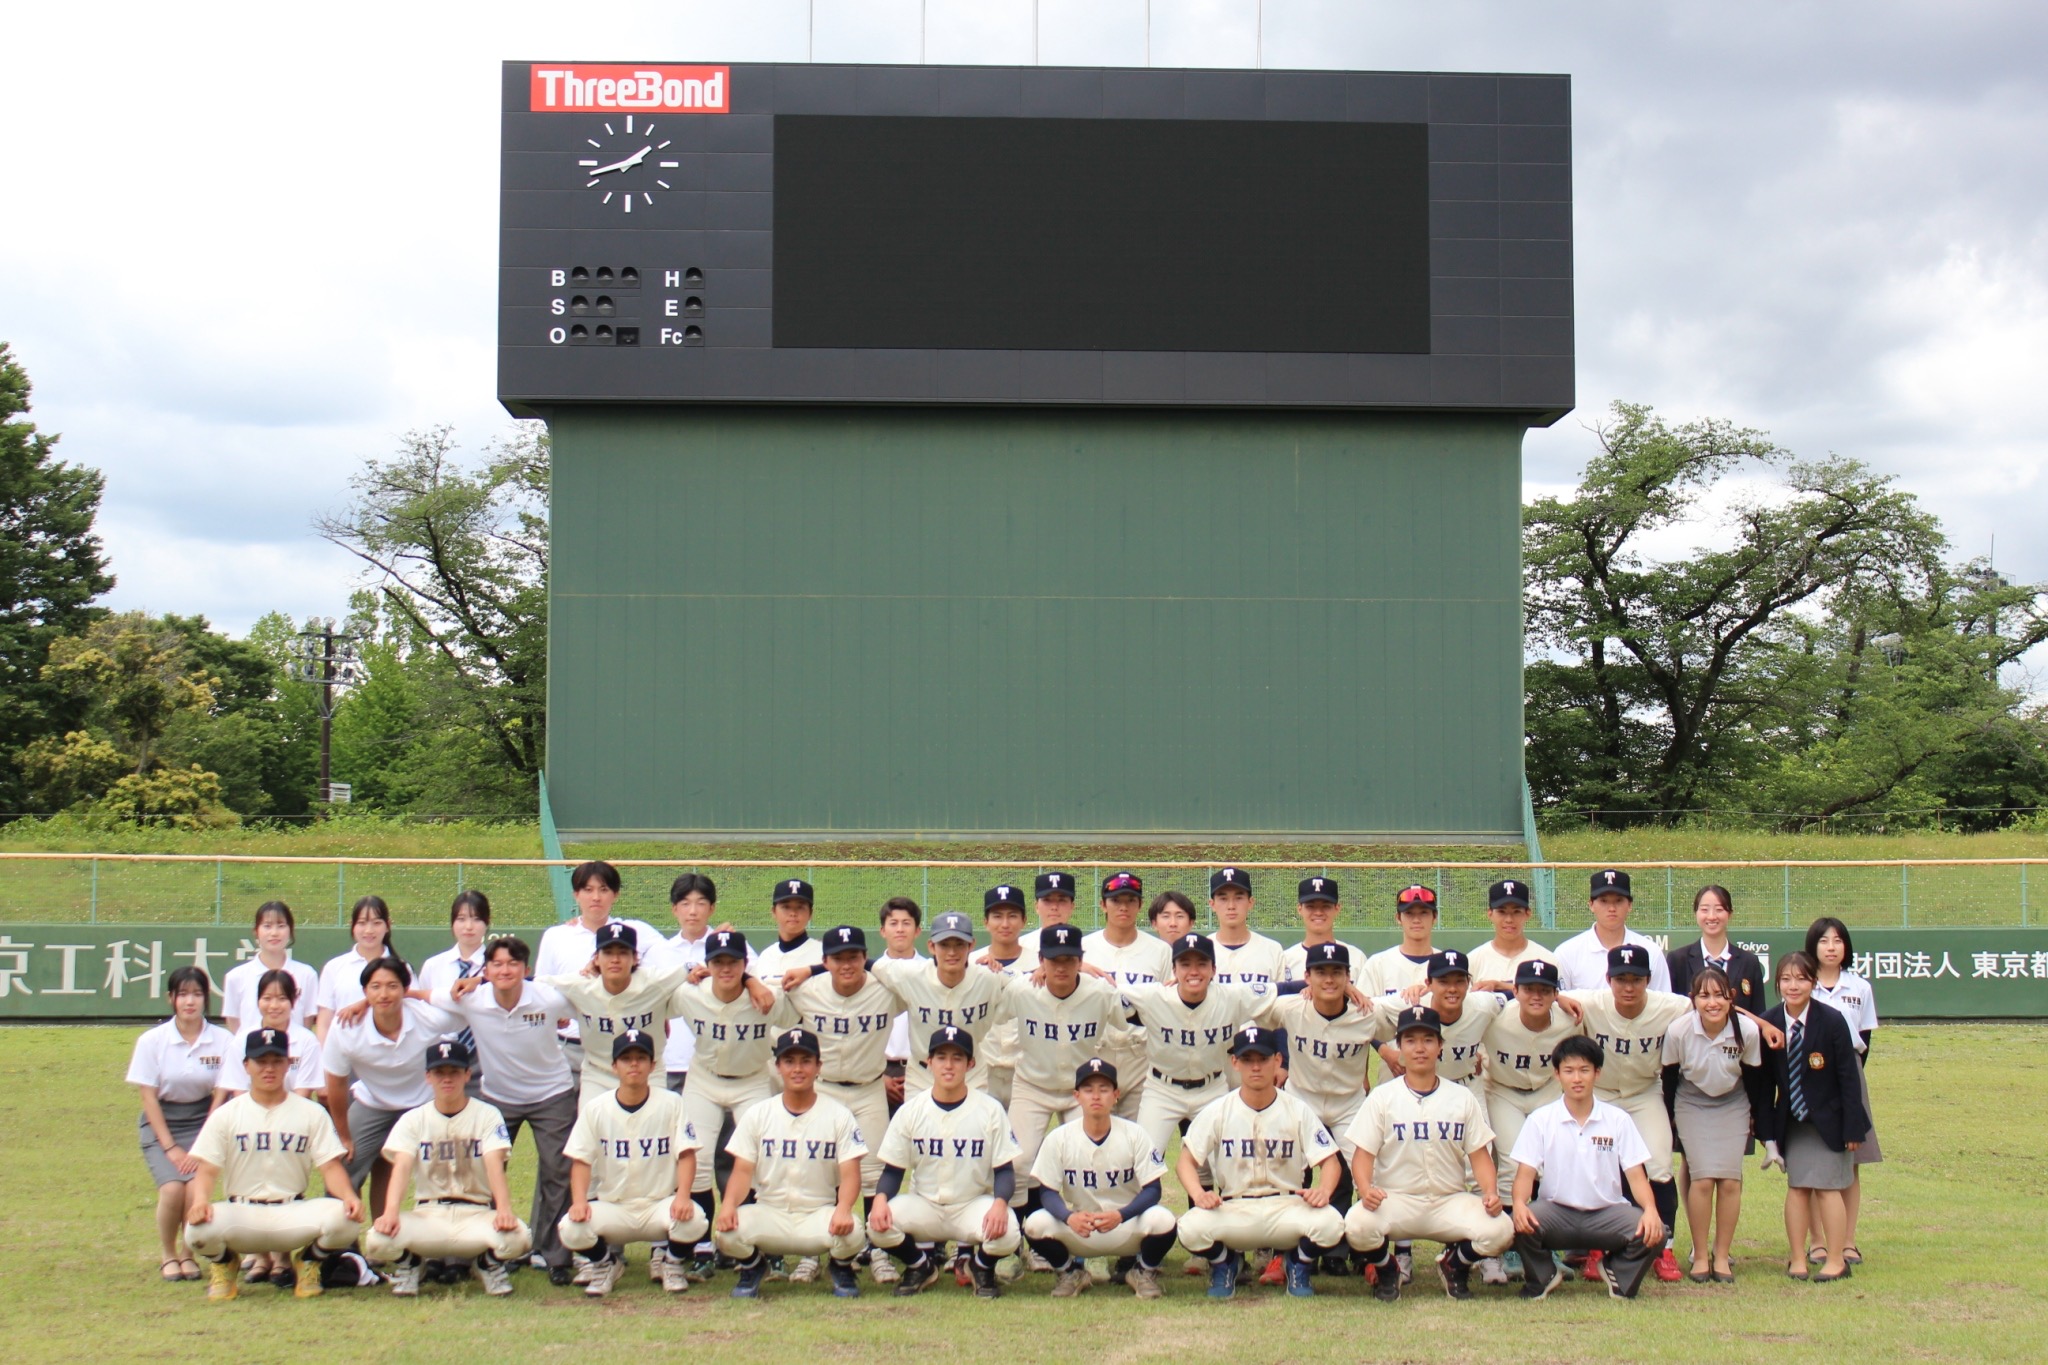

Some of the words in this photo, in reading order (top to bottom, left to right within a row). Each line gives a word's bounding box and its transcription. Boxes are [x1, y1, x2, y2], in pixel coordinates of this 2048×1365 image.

[537, 70, 723, 108] ThreeBond
[552, 270, 565, 287] B
[665, 271, 680, 287] H
[552, 299, 565, 315] S
[666, 300, 678, 316] E
[661, 328, 683, 345] Fc
[1049, 875, 1060, 887] T
[1223, 869, 1234, 881] T
[1605, 872, 1615, 884] T
[789, 881, 800, 893] T
[1313, 879, 1323, 891] T
[1504, 882, 1514, 894] T
[998, 887, 1009, 899] T
[947, 916, 958, 928] T
[610, 924, 623, 939] T
[839, 928, 850, 942] T
[1057, 930, 1068, 943] T
[718, 933, 729, 946] T
[1186, 935, 1197, 947] T
[1324, 945, 1335, 958] T
[1737, 941, 1769, 953] Tokyo
[1446, 952, 1456, 965] T
[1621, 950, 1632, 963] T
[1533, 962, 1544, 975] T
[1848, 951, 1961, 979] 財団法人
[1971, 951, 2048, 978] 東京都
[919, 1002, 988, 1024] TOYO
[1413, 1007, 1424, 1020] T
[583, 1012, 652, 1034] TOYO
[694, 1019, 766, 1041] TOYO
[815, 1013, 888, 1034] TOYO
[1026, 1019, 1097, 1041] TOYO
[262, 1030, 275, 1044] T
[626, 1029, 639, 1043] T
[790, 1030, 802, 1043] T
[945, 1027, 958, 1040] T
[1161, 1023, 1232, 1046] TOYO
[1246, 1028, 1257, 1042] T
[440, 1044, 451, 1057] T
[1090, 1059, 1102, 1072] T
[1497, 1050, 1552, 1069] TOY
[1393, 1122, 1464, 1141] TOYO
[420, 1140, 482, 1160] TOYO
[600, 1137, 669, 1158] TOYO
[763, 1139, 836, 1159] TOYO
[913, 1139, 984, 1157] TOYO
[1222, 1139, 1293, 1158] TOYO
[1064, 1166, 1134, 1190] TOYO
